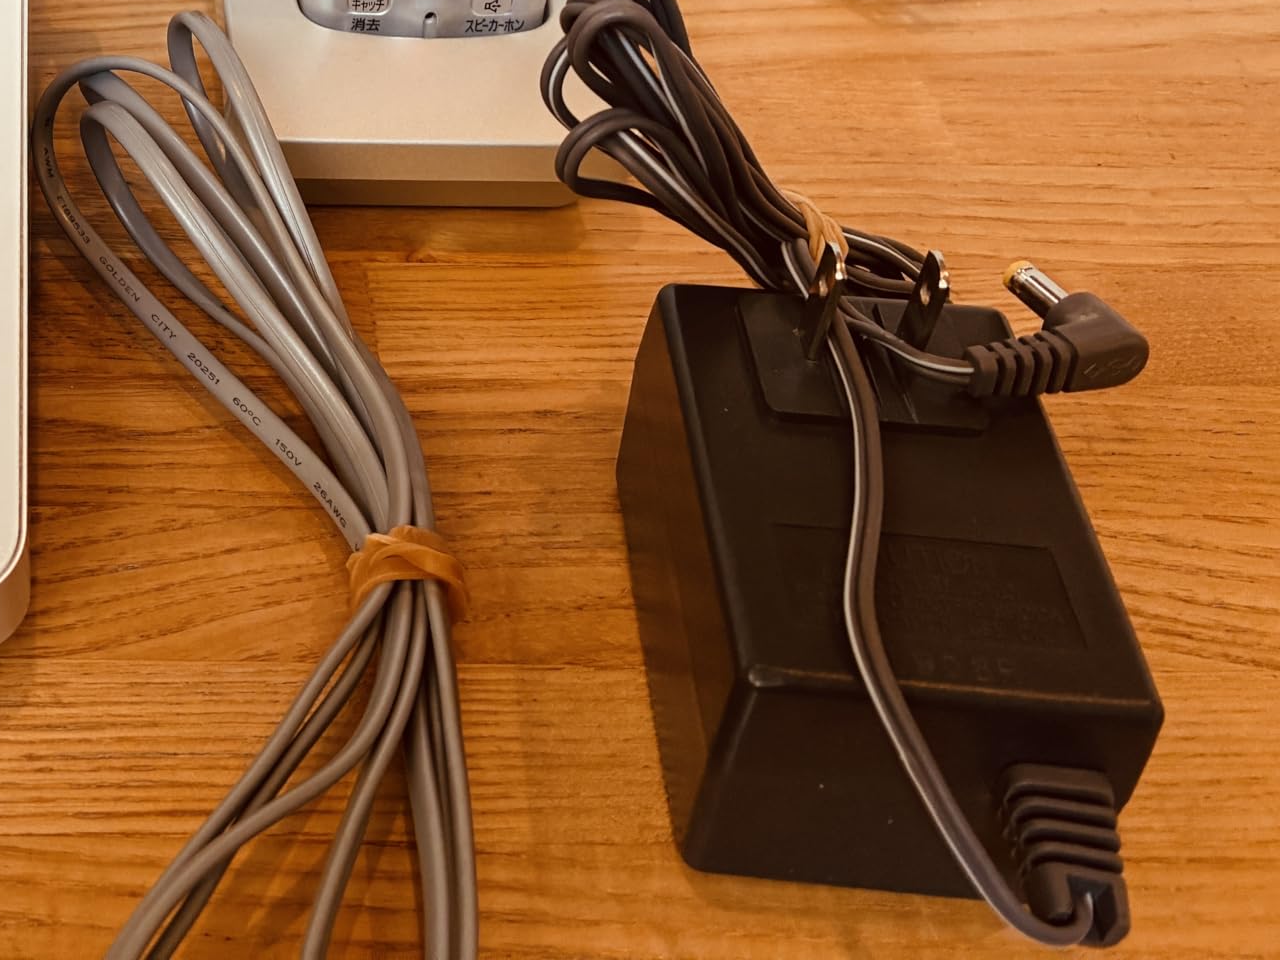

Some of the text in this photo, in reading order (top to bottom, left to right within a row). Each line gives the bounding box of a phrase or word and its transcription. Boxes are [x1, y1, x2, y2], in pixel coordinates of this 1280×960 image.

[351, 18, 380, 32] 消去
[465, 18, 525, 32] スピーカーホン
[98, 255, 141, 303] GOLDEN
[150, 313, 177, 339] CITY
[186, 351, 220, 385] 20251
[274, 438, 302, 466] 150V
[313, 481, 347, 528] 26AWG
